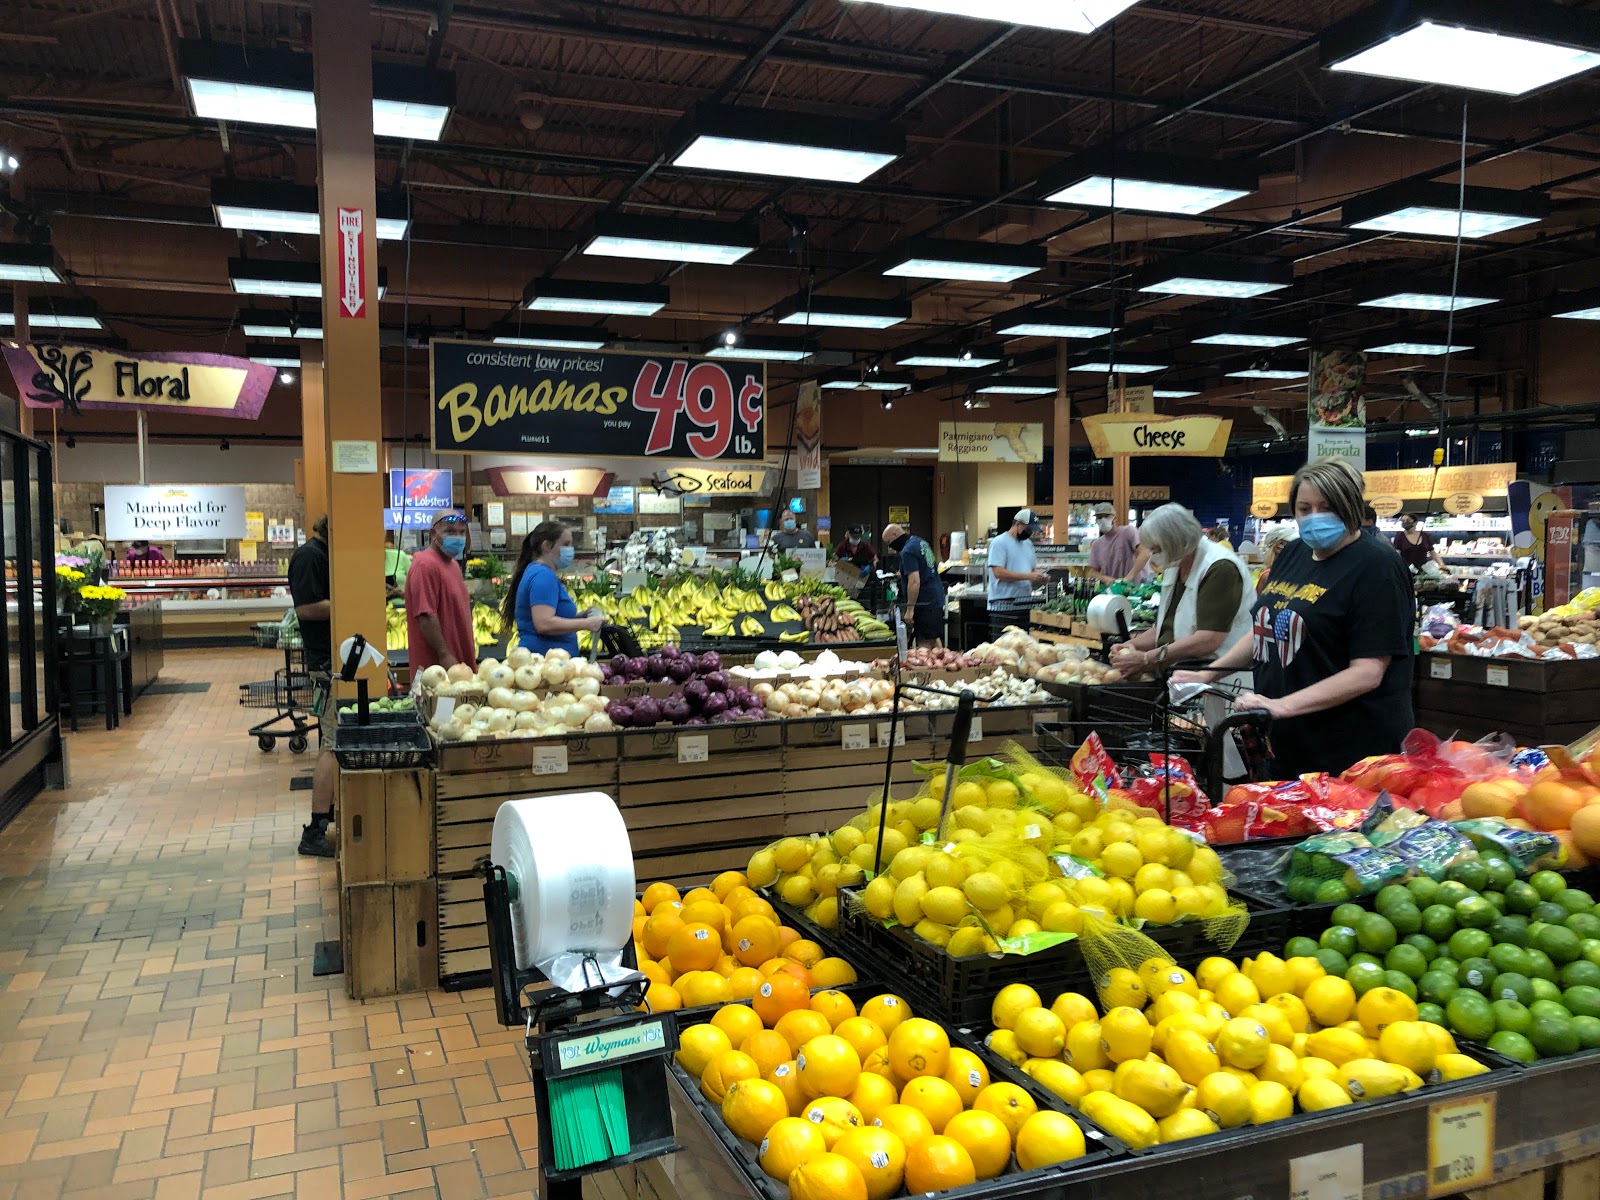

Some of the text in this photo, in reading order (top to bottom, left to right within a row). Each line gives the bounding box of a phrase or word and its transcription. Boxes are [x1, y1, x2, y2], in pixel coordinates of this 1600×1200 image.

[342, 216, 359, 227] FIRE
[348, 231, 356, 308] EXTINGUISHER
[466, 351, 605, 373] consistent low prices!
[115, 361, 191, 401] Floral
[438, 378, 628, 443] Bananas
[603, 419, 632, 430] you pay
[734, 434, 756, 455] lb.
[943, 431, 994, 444] Parmigiano
[1133, 424, 1186, 450] Cheese
[947, 442, 988, 455] Reggiano
[1316, 443, 1361, 458] Burrata
[536, 474, 568, 493] Meat
[706, 473, 752, 492] Seafood
[414, 495, 450, 507] Lobsters
[1070, 490, 1165, 500] FROZEN AFOOD
[126, 500, 227, 515] Marinated for
[134, 515, 221, 531] Deep Flavor
[392, 512, 411, 524] We
[584, 1036, 640, 1059] Wegmans
